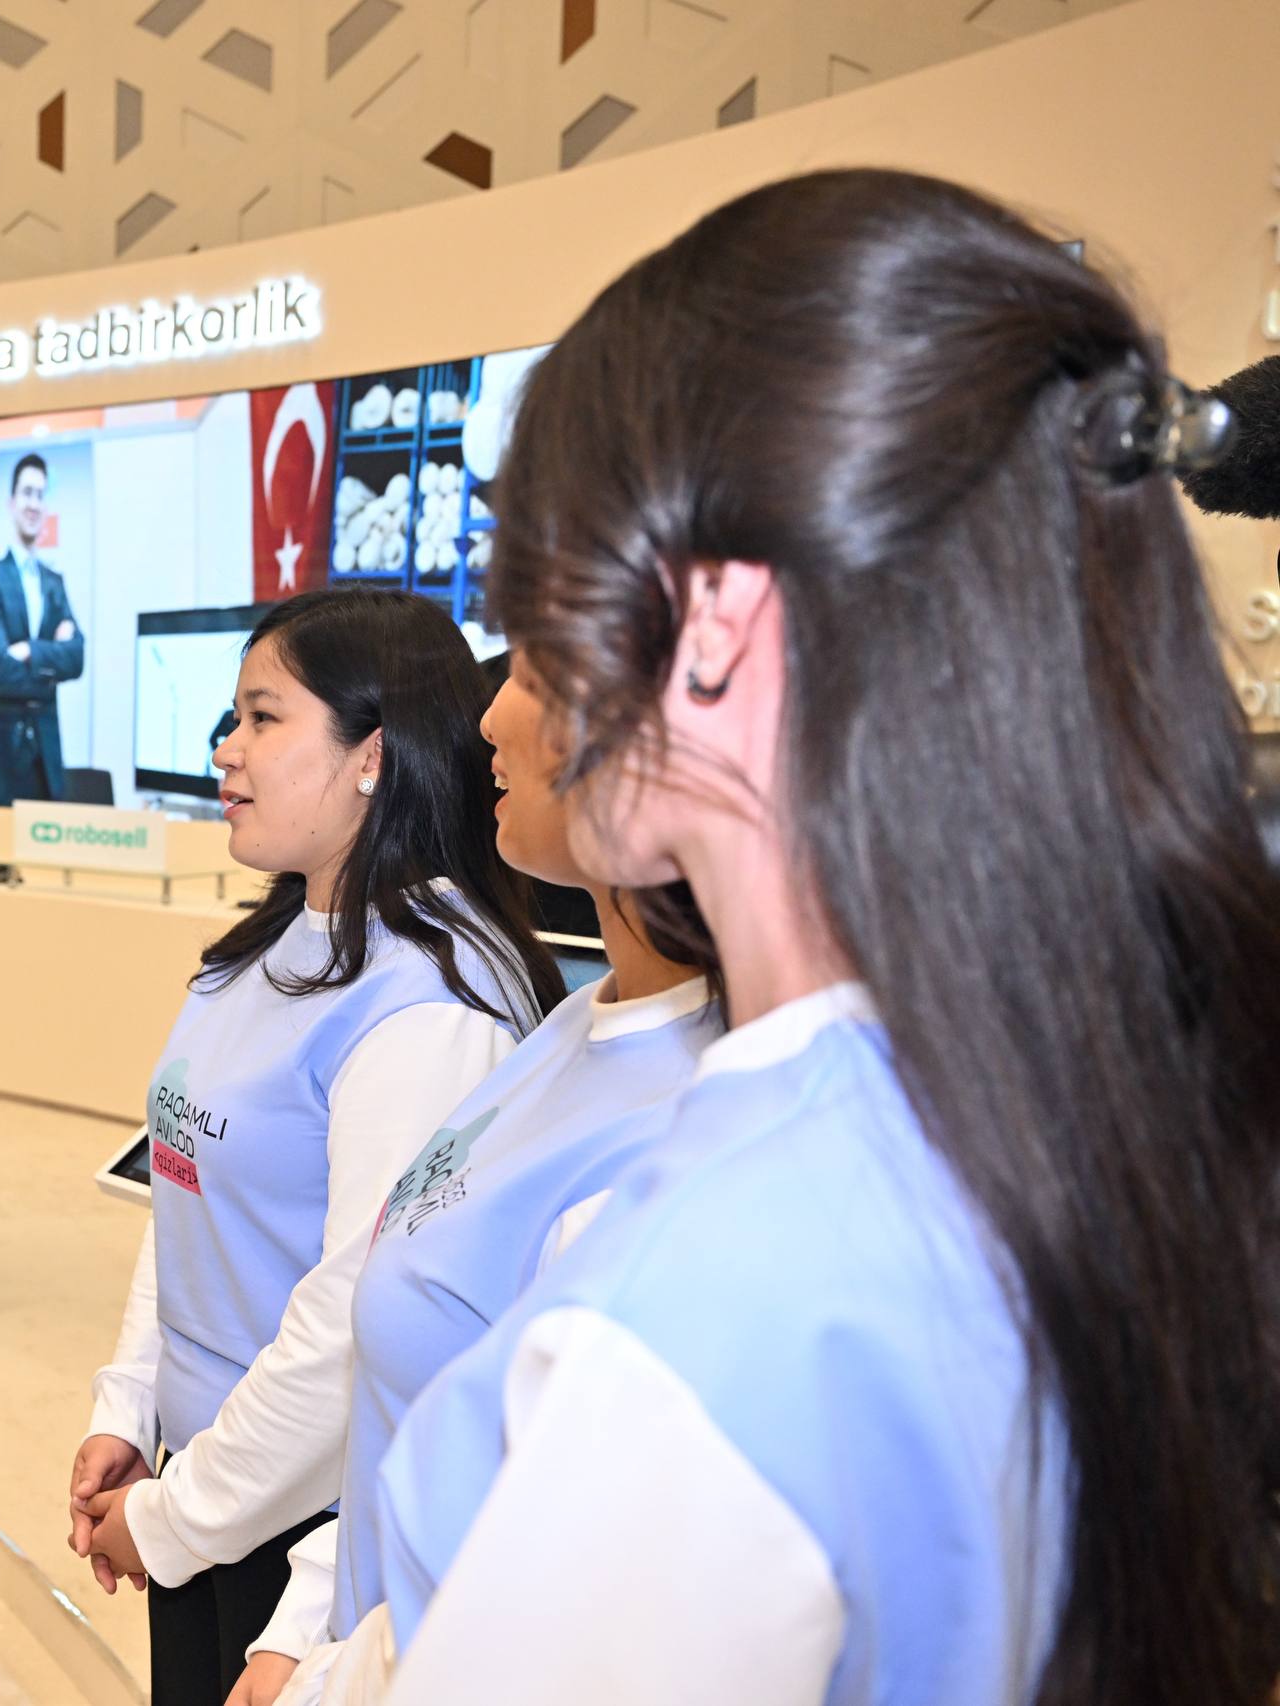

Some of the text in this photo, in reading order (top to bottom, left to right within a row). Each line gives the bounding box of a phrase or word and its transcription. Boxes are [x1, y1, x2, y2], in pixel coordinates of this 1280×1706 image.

[33, 280, 312, 366] tadbirkorlik
[65, 823, 148, 849] robosell
[154, 1116, 196, 1160] AVLOD
[156, 1086, 229, 1141] RAQAMLI
